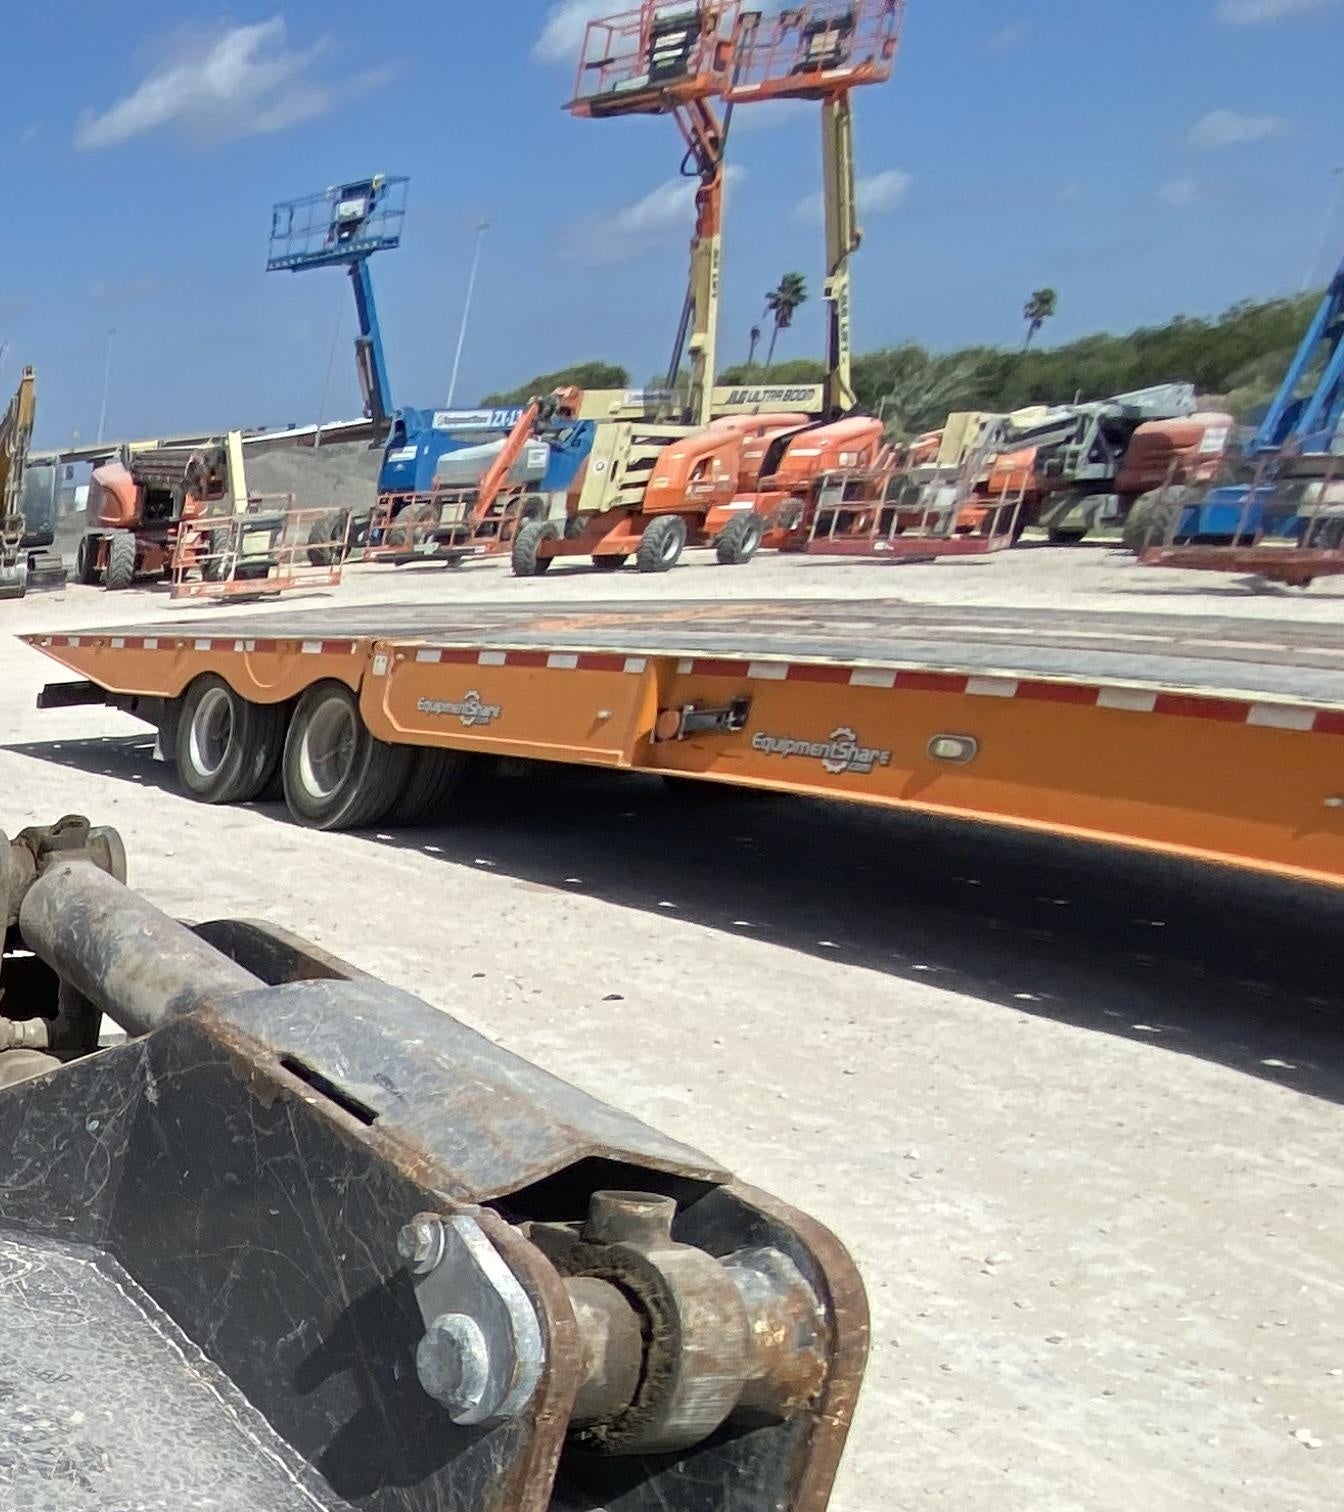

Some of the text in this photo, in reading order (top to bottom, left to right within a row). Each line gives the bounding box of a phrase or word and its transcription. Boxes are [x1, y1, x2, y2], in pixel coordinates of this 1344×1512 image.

[748, 389, 784, 403] ULTRA
[782, 388, 815, 402] BOOM
[752, 732, 892, 766] EquipmentShare
